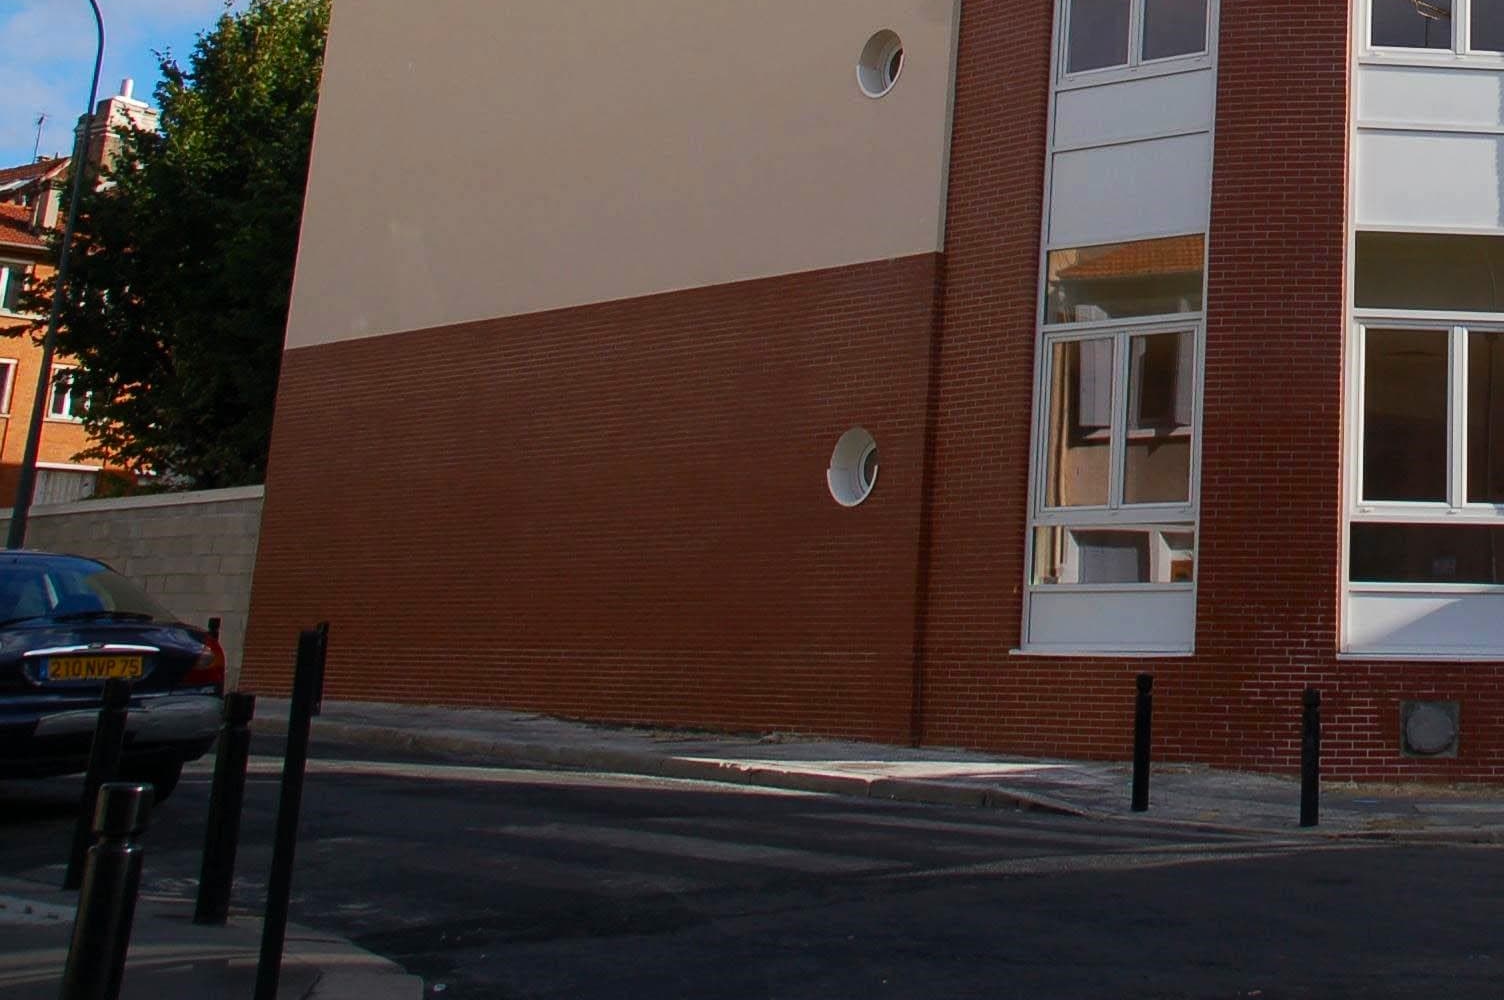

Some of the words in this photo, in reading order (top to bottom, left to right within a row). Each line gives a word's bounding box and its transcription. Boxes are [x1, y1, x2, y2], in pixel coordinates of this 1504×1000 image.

[51, 660, 82, 677] 210
[86, 659, 116, 677] NVP
[119, 658, 139, 677] 75
